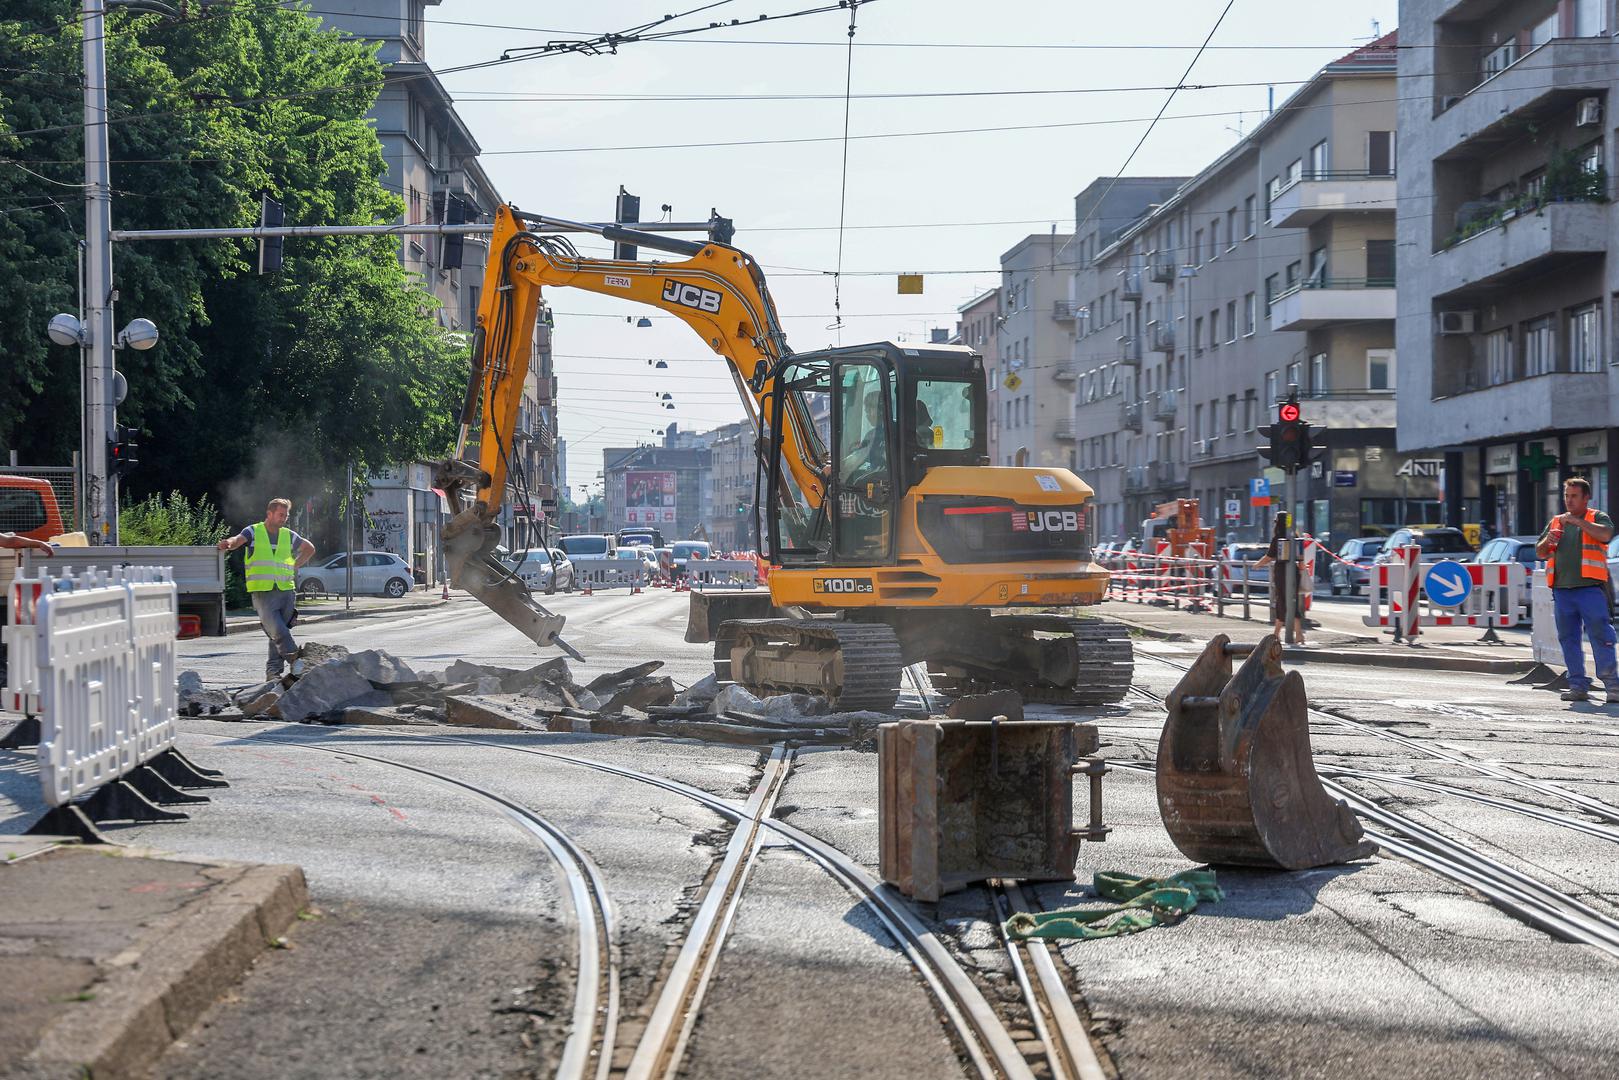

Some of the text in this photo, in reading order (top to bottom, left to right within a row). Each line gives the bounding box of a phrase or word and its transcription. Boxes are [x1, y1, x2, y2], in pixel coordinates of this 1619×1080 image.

[606, 276, 629, 286] TERRA
[663, 282, 720, 312] JCB
[1028, 511, 1078, 532] JCB
[824, 579, 855, 592] 100
